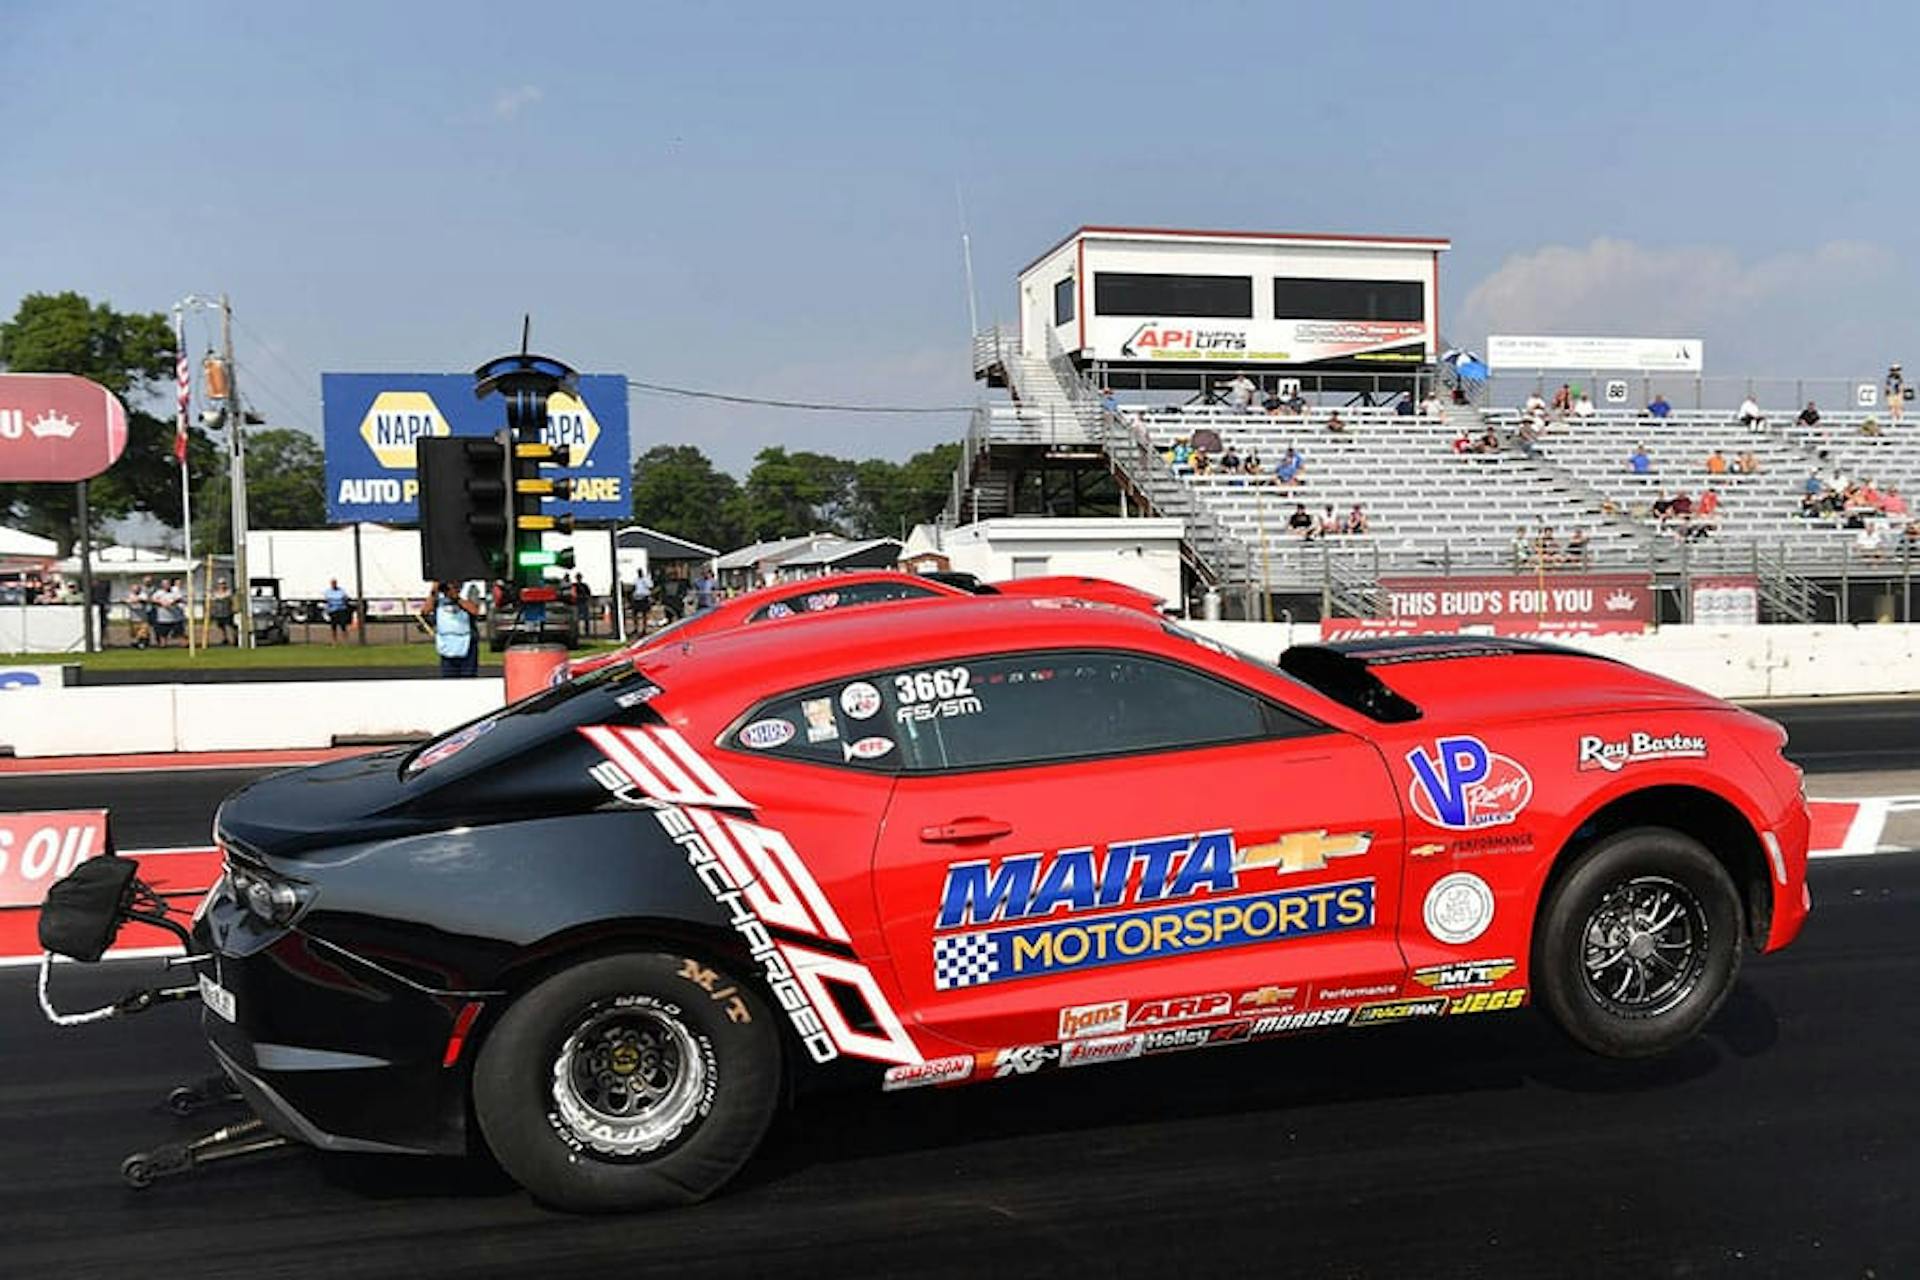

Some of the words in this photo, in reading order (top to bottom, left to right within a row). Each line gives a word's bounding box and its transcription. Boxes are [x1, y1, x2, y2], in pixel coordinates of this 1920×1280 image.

[1196, 338, 1247, 349] LIFTS
[377, 415, 433, 444] NAPA
[546, 415, 585, 444] APA
[338, 479, 401, 503] AUTO
[1388, 592, 1437, 616] THIS
[1441, 590, 1503, 616] BUD'S
[1509, 589, 1548, 613] FOR
[1552, 588, 1593, 613] YOU
[895, 666, 974, 703] 3662
[1580, 736, 1628, 770] Ray
[1631, 732, 1707, 754] Barton
[1406, 735, 1492, 828] VP
[935, 829, 1238, 930] MAITA
[1011, 888, 1365, 972] MOTORSPORTS
[1440, 967, 1493, 983] M/T
[677, 958, 752, 1025] M/T
[1319, 985, 1397, 1000] Performance
[1450, 989, 1526, 1015] JEGS
[1063, 1004, 1122, 1034] hans
[1127, 992, 1232, 1027] ARP
[1147, 1027, 1210, 1049] Holley
